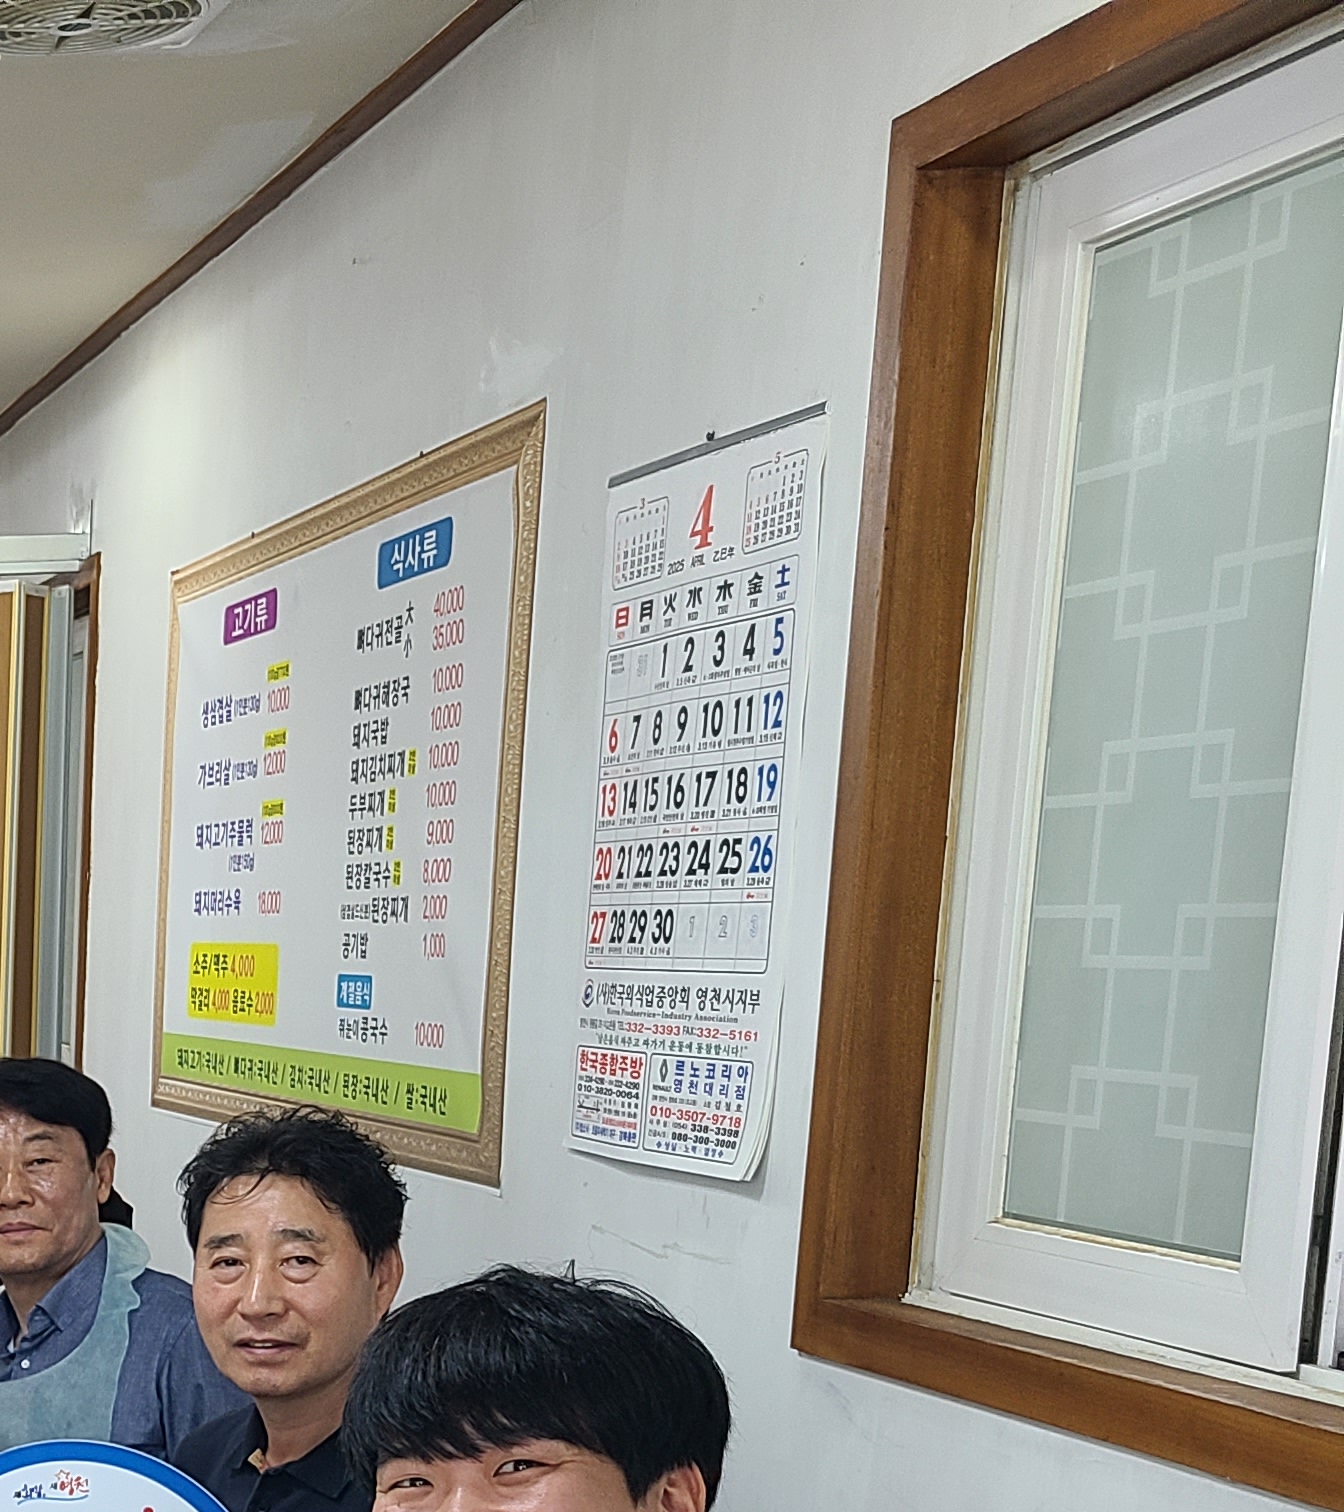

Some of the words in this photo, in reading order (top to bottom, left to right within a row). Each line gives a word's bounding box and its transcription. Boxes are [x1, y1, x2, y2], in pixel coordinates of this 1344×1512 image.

[688, 483, 715, 551] 4
[391, 529, 438, 577] 식사류
[667, 559, 686, 576] 2025
[433, 585, 465, 618] 40,000
[615, 606, 630, 629] 日
[639, 599, 654, 622] 月
[663, 591, 678, 616] 火
[685, 586, 703, 608] 水
[715, 579, 734, 602] 木
[746, 571, 764, 597] 金
[774, 563, 791, 589] 土
[231, 597, 268, 637] 고기류
[357, 614, 403, 653] 뼈다귀전골
[661, 642, 668, 678] 1
[682, 636, 695, 674] 2
[712, 629, 726, 668] 3
[742, 623, 756, 661] 4
[772, 616, 785, 656] 5
[354, 675, 411, 714] 뼈다귀해장국
[433, 662, 464, 694] 10,000
[352, 716, 389, 750] 돼지국밥
[431, 701, 462, 732] 10,000
[608, 718, 619, 754] 6
[630, 714, 642, 750] 7
[652, 710, 663, 746] 8
[676, 705, 688, 742] 9
[701, 699, 724, 738] 10
[733, 695, 754, 735] 11
[763, 690, 784, 731] 12
[198, 757, 231, 790] 가브리살
[350, 749, 405, 785] 돼지김치찌개
[429, 740, 460, 770] 10,000
[349, 789, 386, 821] 두부찌개
[426, 780, 457, 808] 10,000
[601, 782, 617, 818] 13
[622, 779, 639, 816] 14
[643, 776, 659, 813] 15
[665, 772, 686, 810] 16
[694, 769, 719, 808] 17
[726, 766, 749, 805] 18
[757, 763, 778, 803] 19
[196, 817, 254, 850] 돼지고기주물럭
[347, 825, 383, 856] 된장찌개
[426, 818, 454, 847] 9,000
[345, 860, 391, 890] 된장칼국수
[423, 857, 452, 886] 8,000
[594, 846, 612, 881] 20
[615, 844, 633, 880] 21
[634, 843, 654, 879] 22
[657, 840, 681, 877] 23
[684, 839, 711, 877] 24
[716, 837, 743, 875] 25
[747, 834, 773, 874] 26
[422, 895, 448, 922] 2,000
[589, 911, 608, 944] 27
[608, 909, 626, 944] 28
[627, 909, 648, 944] 29
[651, 908, 675, 945] 30
[342, 932, 369, 959] 공기밥
[422, 933, 446, 961] 1,000
[230, 954, 255, 980] 4,000
[340, 981, 370, 1005] 계절음식
[695, 986, 761, 1015] 영천시지부
[579, 1049, 644, 1080] 한국종합주방
[650, 1105, 742, 1129] 010-3507-9718
